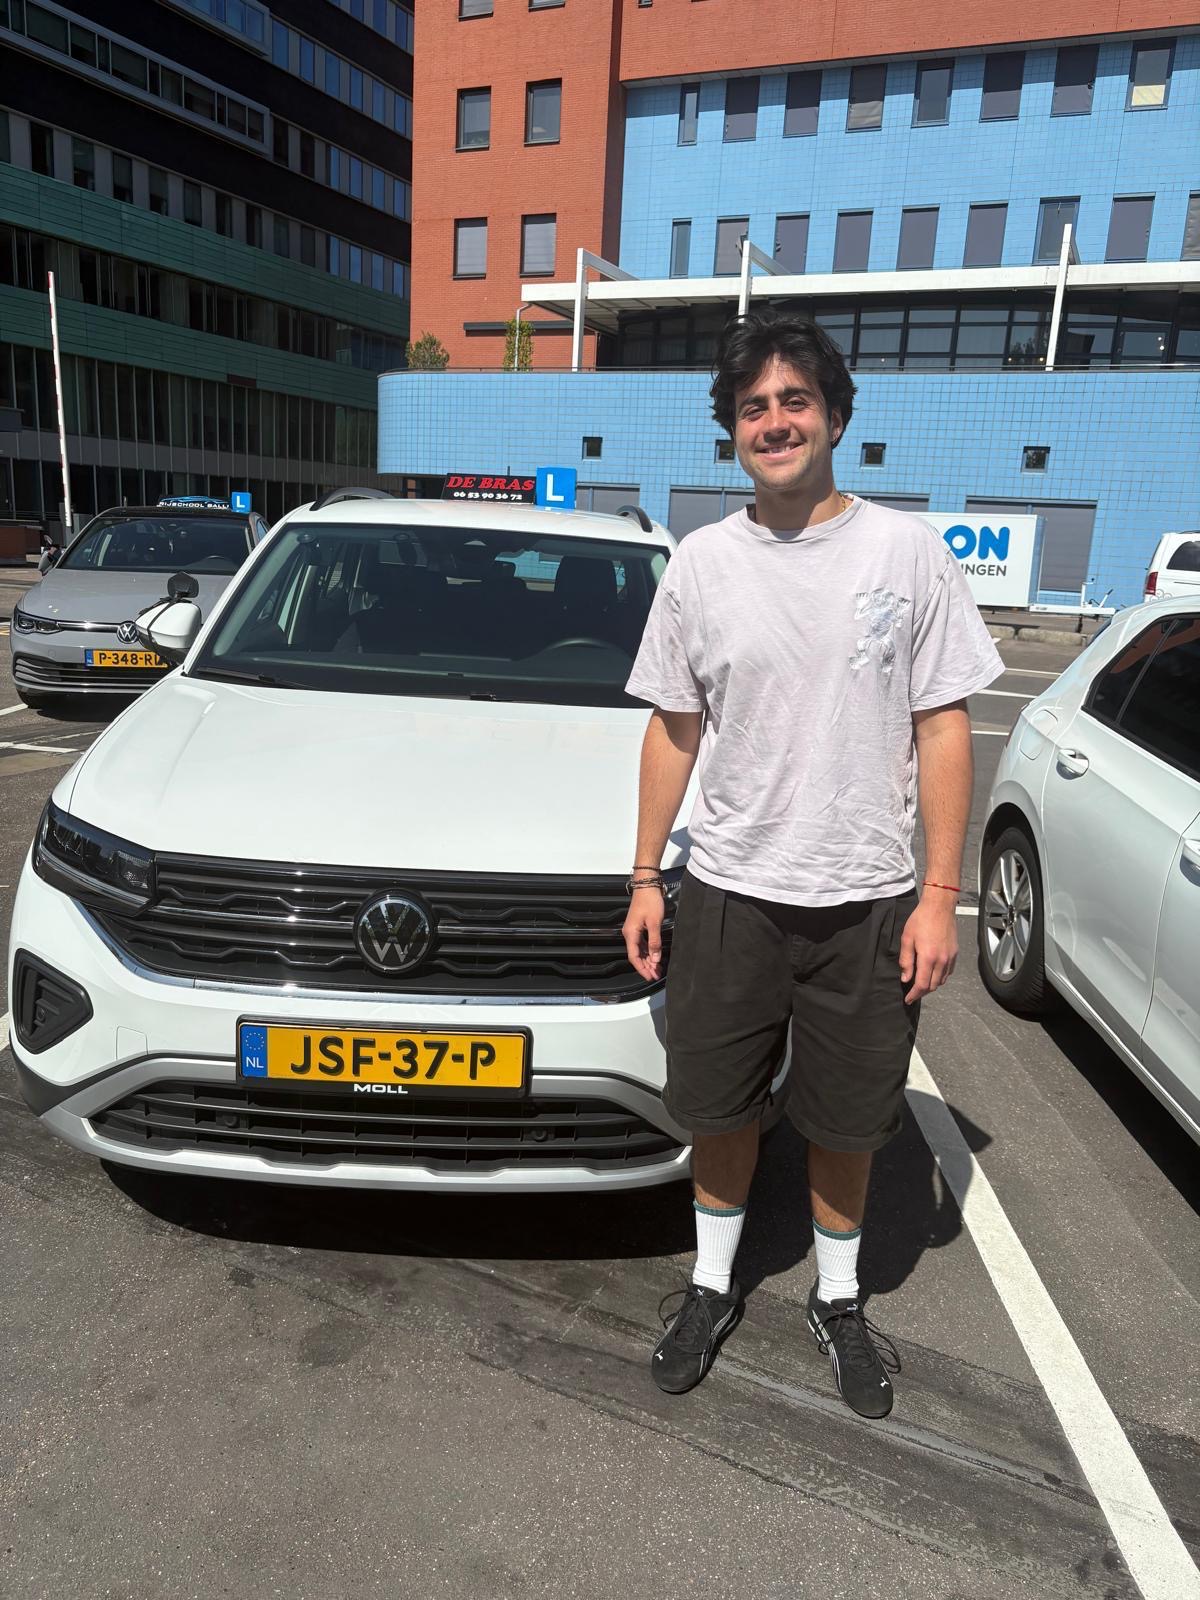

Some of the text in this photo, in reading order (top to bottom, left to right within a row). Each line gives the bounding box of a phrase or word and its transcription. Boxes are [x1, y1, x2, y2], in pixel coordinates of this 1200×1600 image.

[446, 476, 535, 491] DE BRAS
[546, 473, 565, 502] L
[236, 495, 246, 508] L
[943, 524, 1010, 561] ON
[245, 1056, 265, 1069] NL
[290, 1034, 497, 1081] JSF-37-P
[353, 1083, 409, 1095] MOLL
